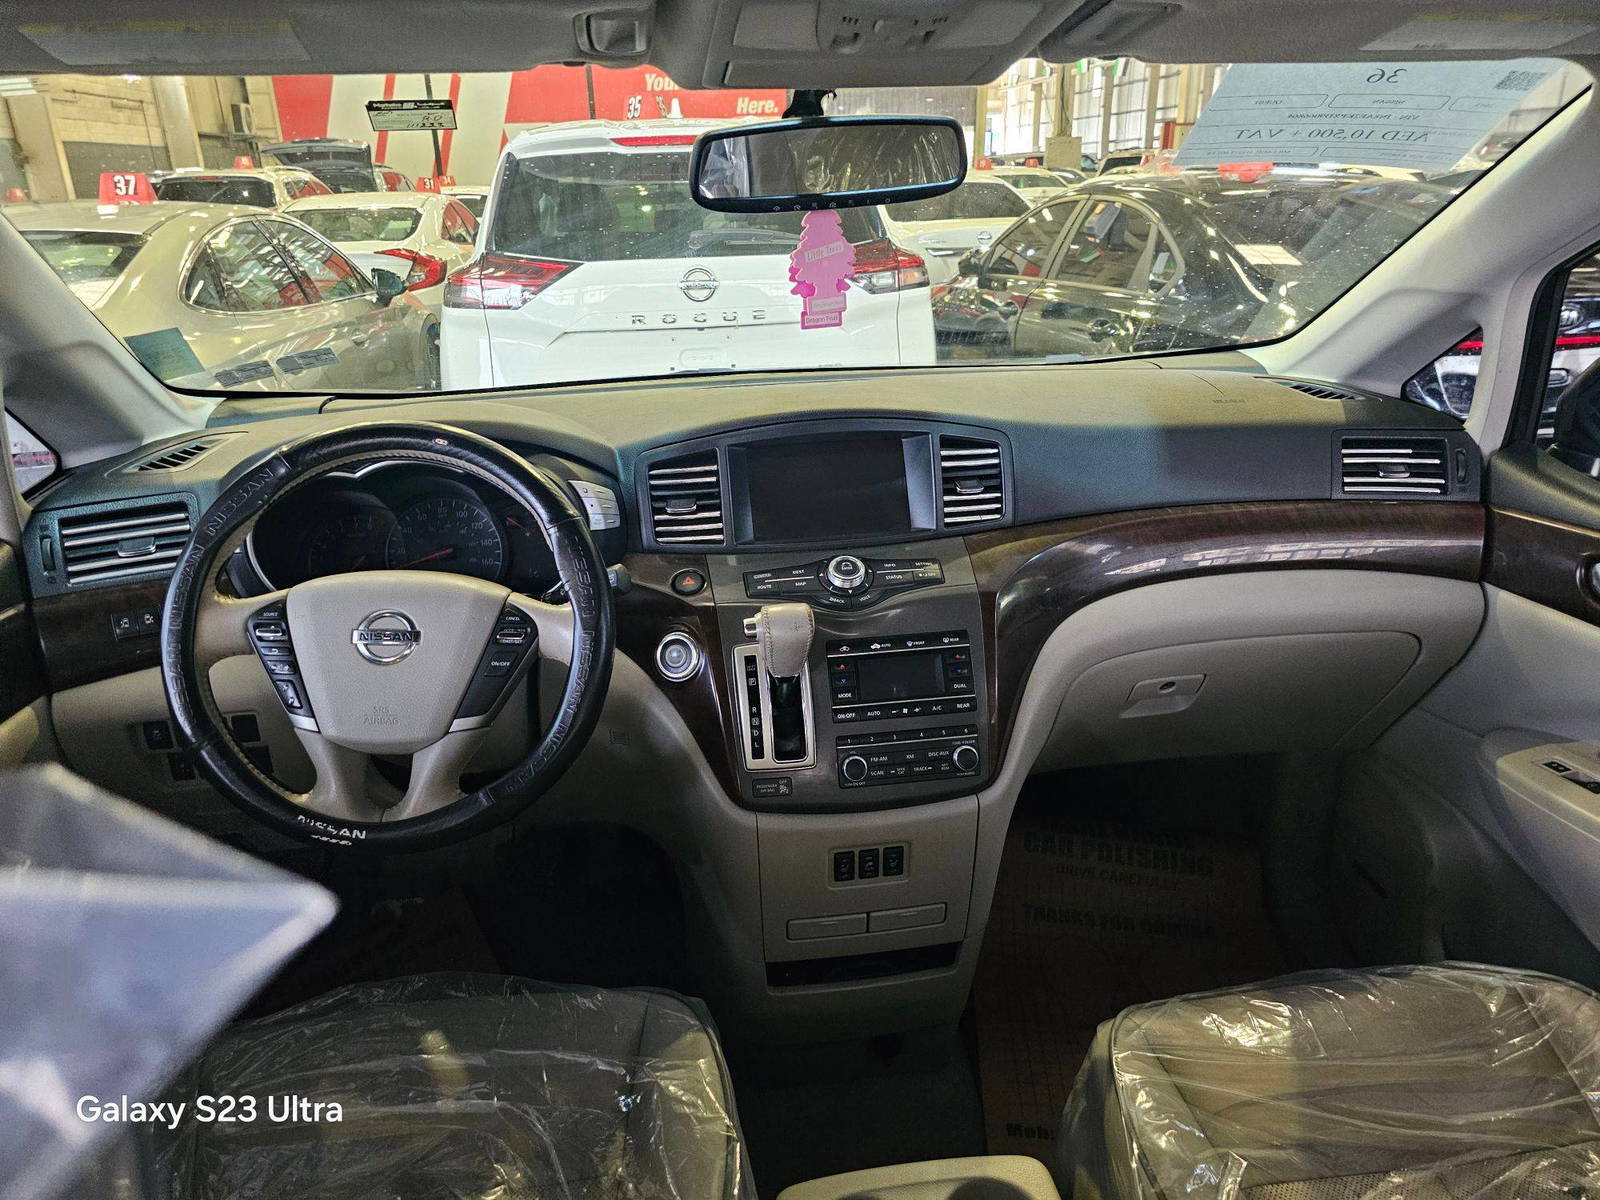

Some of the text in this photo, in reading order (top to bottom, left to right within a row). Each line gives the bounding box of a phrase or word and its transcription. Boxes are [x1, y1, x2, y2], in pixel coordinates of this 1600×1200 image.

[627, 96, 642, 119] 35
[736, 97, 778, 114] Here.
[113, 175, 136, 196] 37
[424, 178, 434, 189] 31
[632, 309, 766, 325] ROGUE
[480, 539, 493, 547] 140
[481, 558, 493, 566] 160
[359, 631, 413, 641] NISSAN
